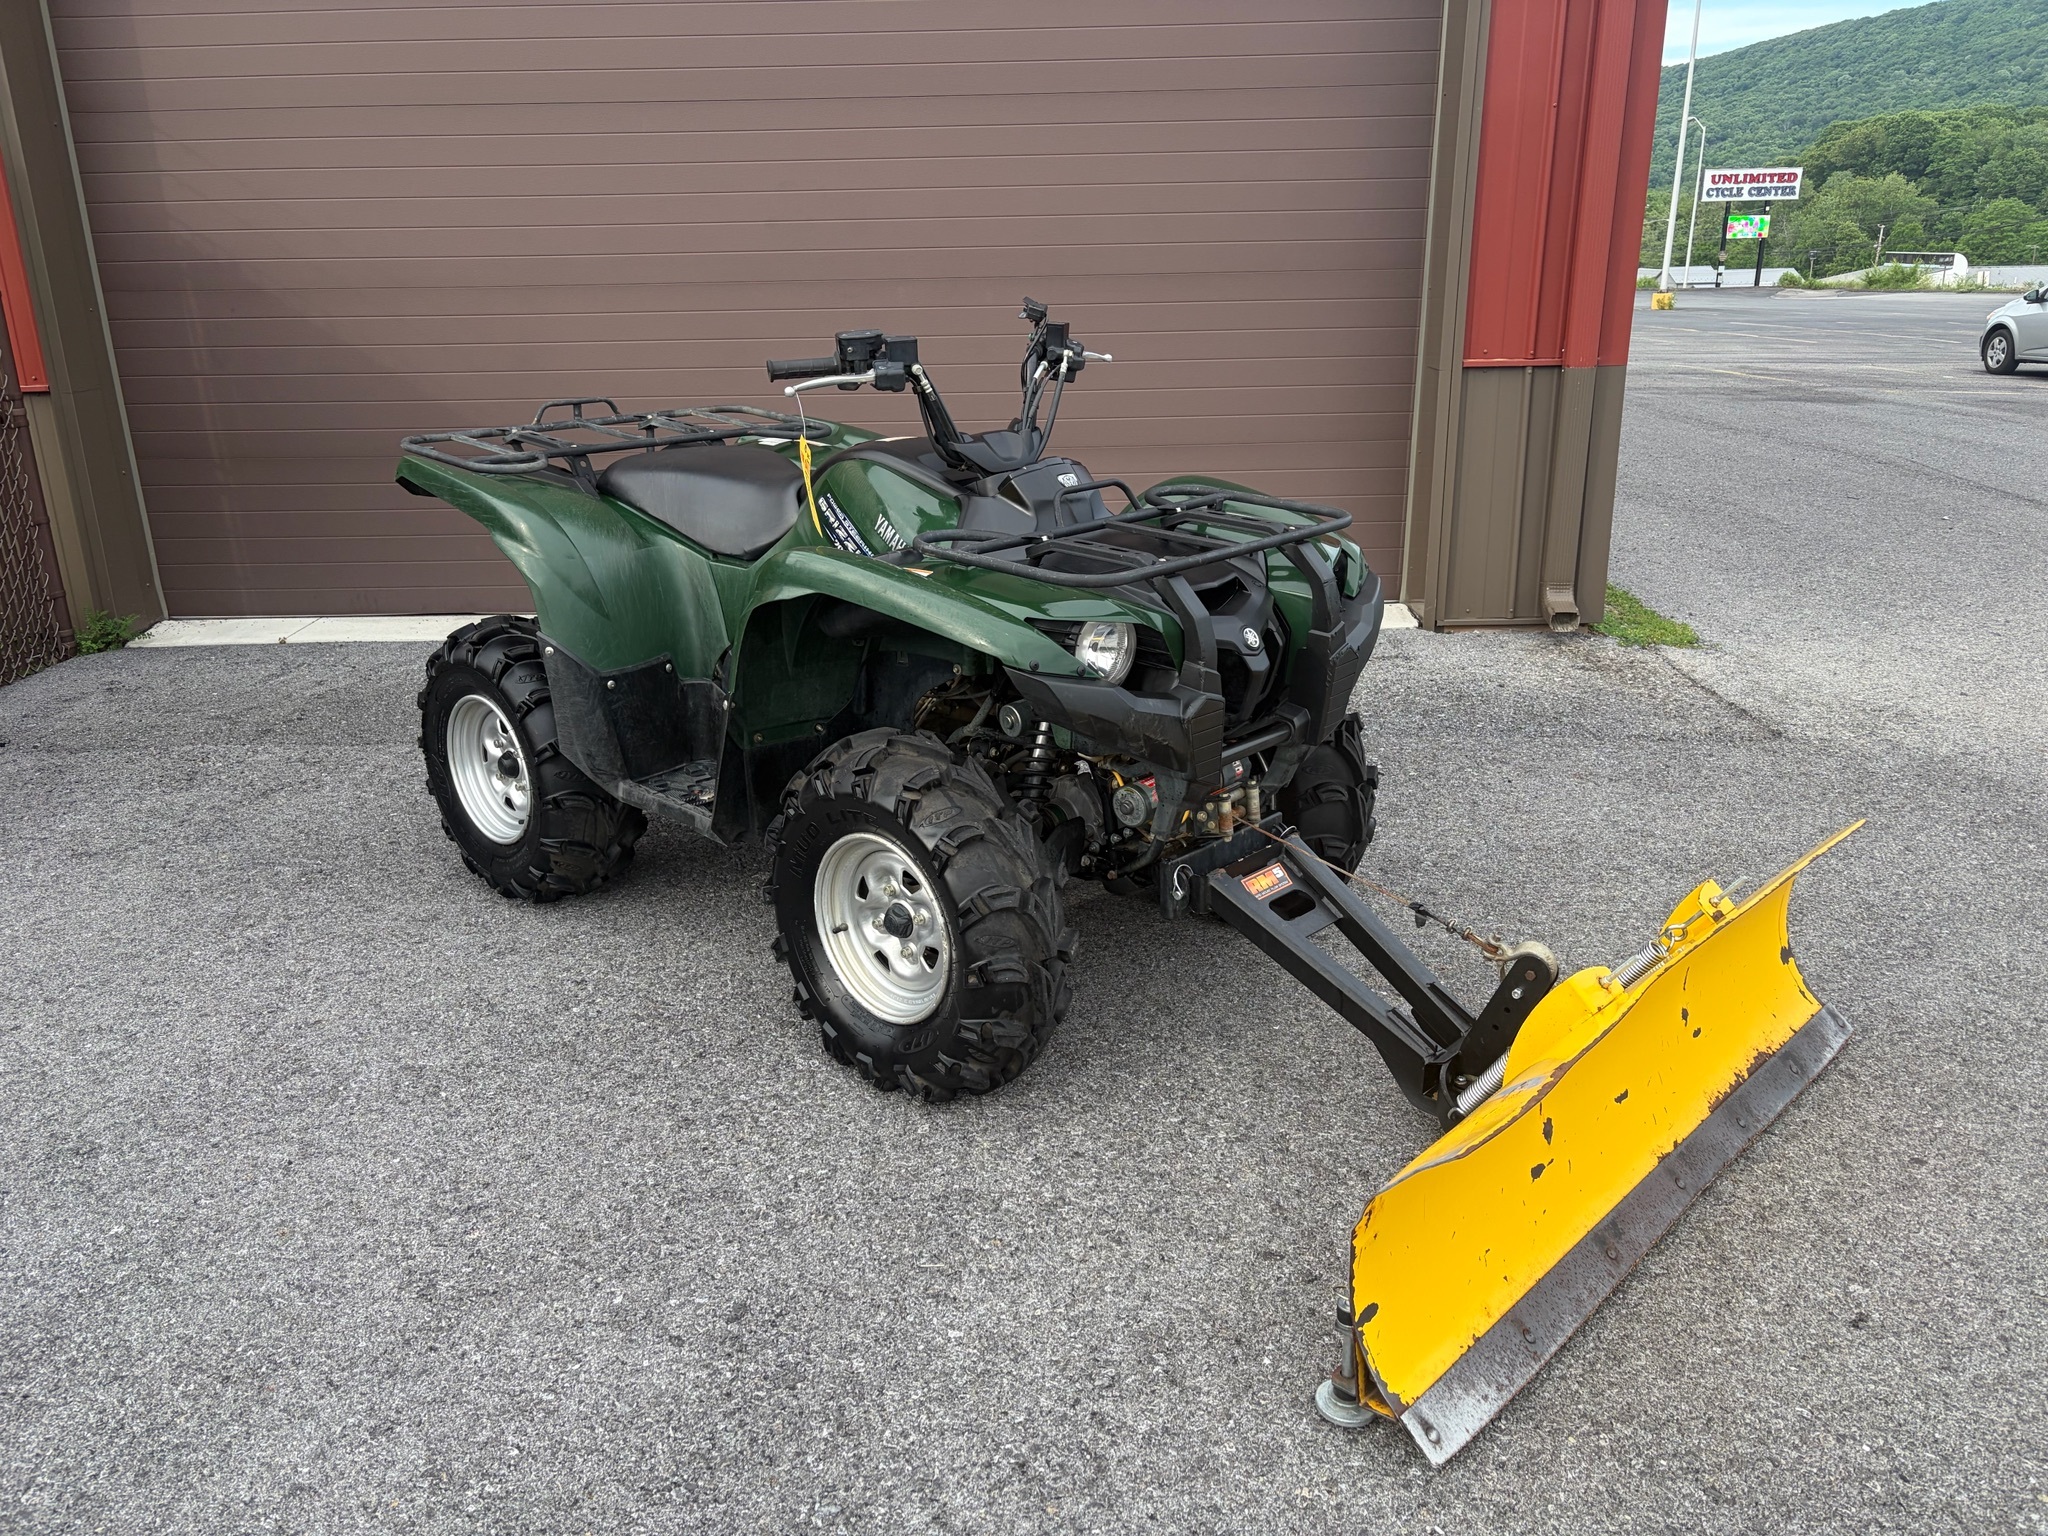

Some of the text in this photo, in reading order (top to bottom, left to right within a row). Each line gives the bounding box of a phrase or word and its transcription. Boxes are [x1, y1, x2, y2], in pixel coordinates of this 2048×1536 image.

[1711, 172, 1798, 185] UNLIMITED
[1706, 186, 1797, 198] CYCLE CENTER
[827, 493, 844, 520] POWER
[874, 513, 908, 550] YAMAH
